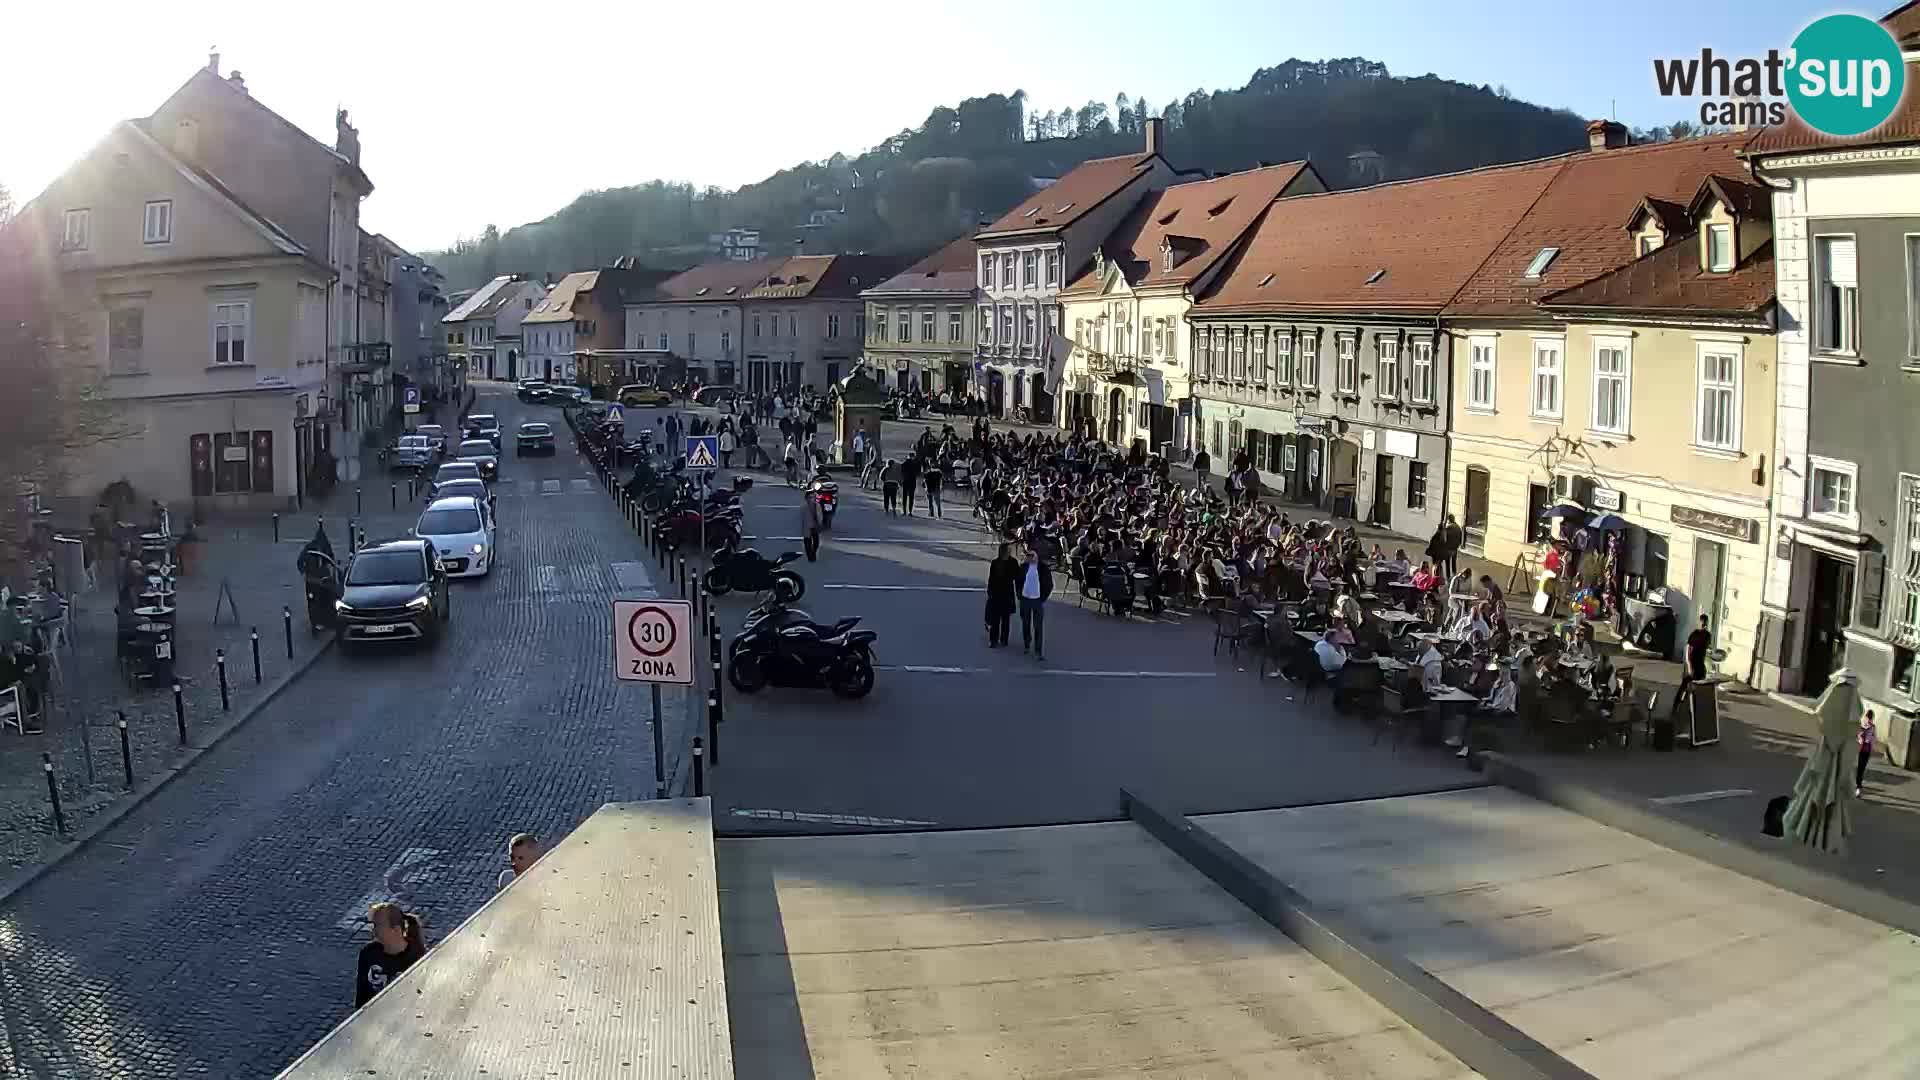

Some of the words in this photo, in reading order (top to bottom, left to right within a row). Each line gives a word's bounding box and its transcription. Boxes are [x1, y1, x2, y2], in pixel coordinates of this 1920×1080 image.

[407, 390, 416, 401] P
[641, 622, 665, 644] 30
[631, 659, 676, 677] ZONA
